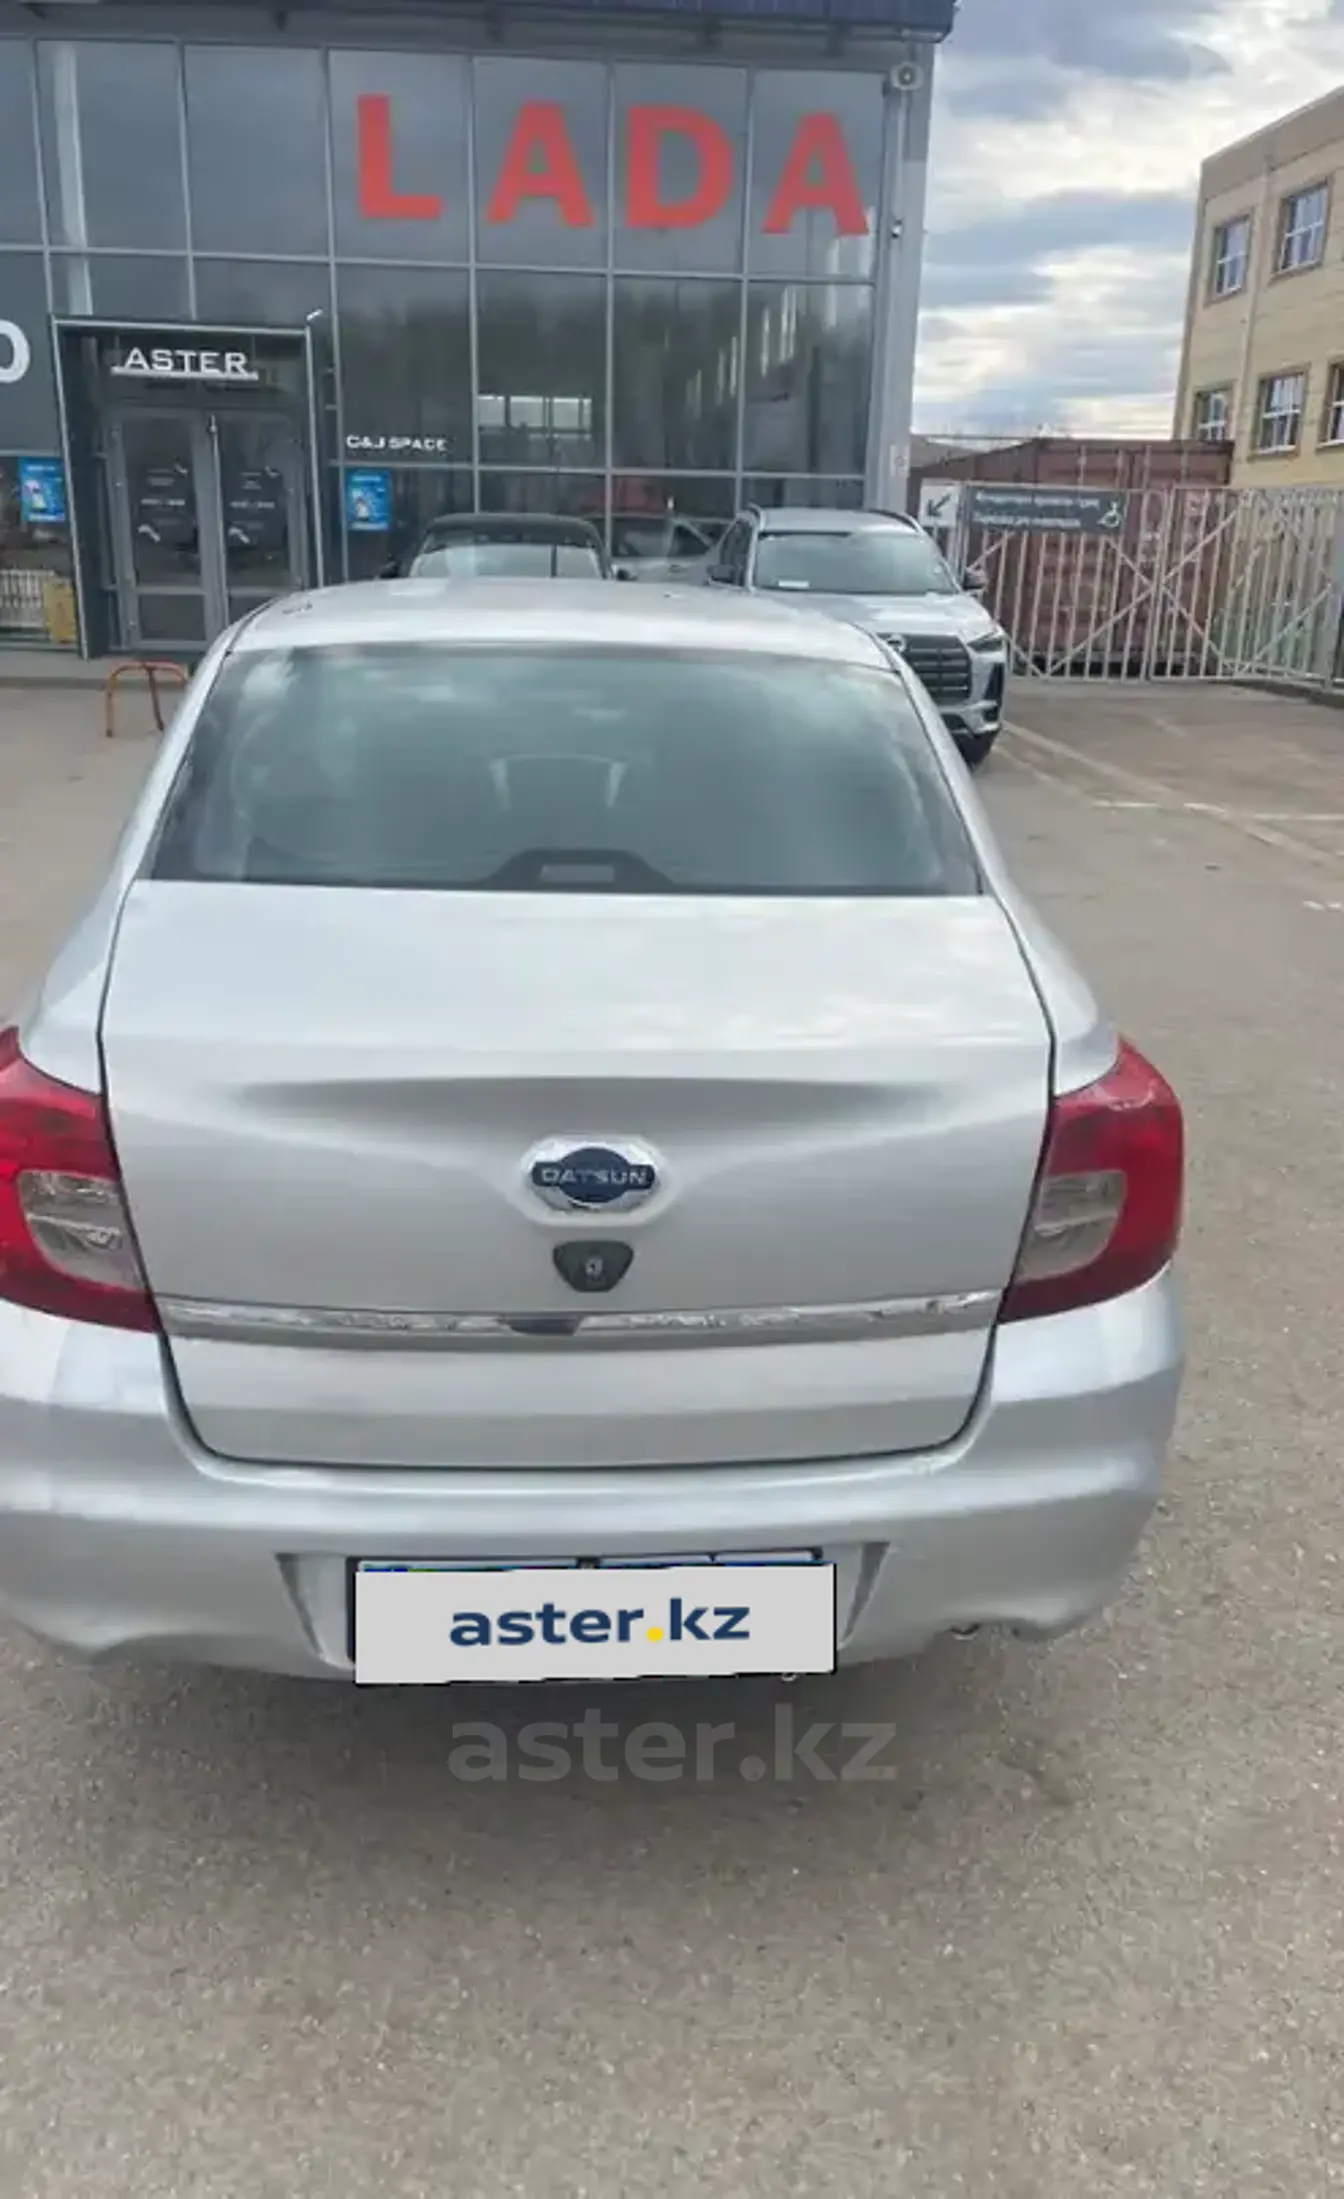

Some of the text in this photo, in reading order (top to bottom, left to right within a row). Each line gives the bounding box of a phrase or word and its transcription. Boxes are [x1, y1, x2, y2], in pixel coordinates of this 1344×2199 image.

[356, 94, 869, 237] LADA
[124, 346, 250, 375] ASTER
[388, 436, 447, 452] SPACE
[541, 1167, 648, 1186] DATSUN
